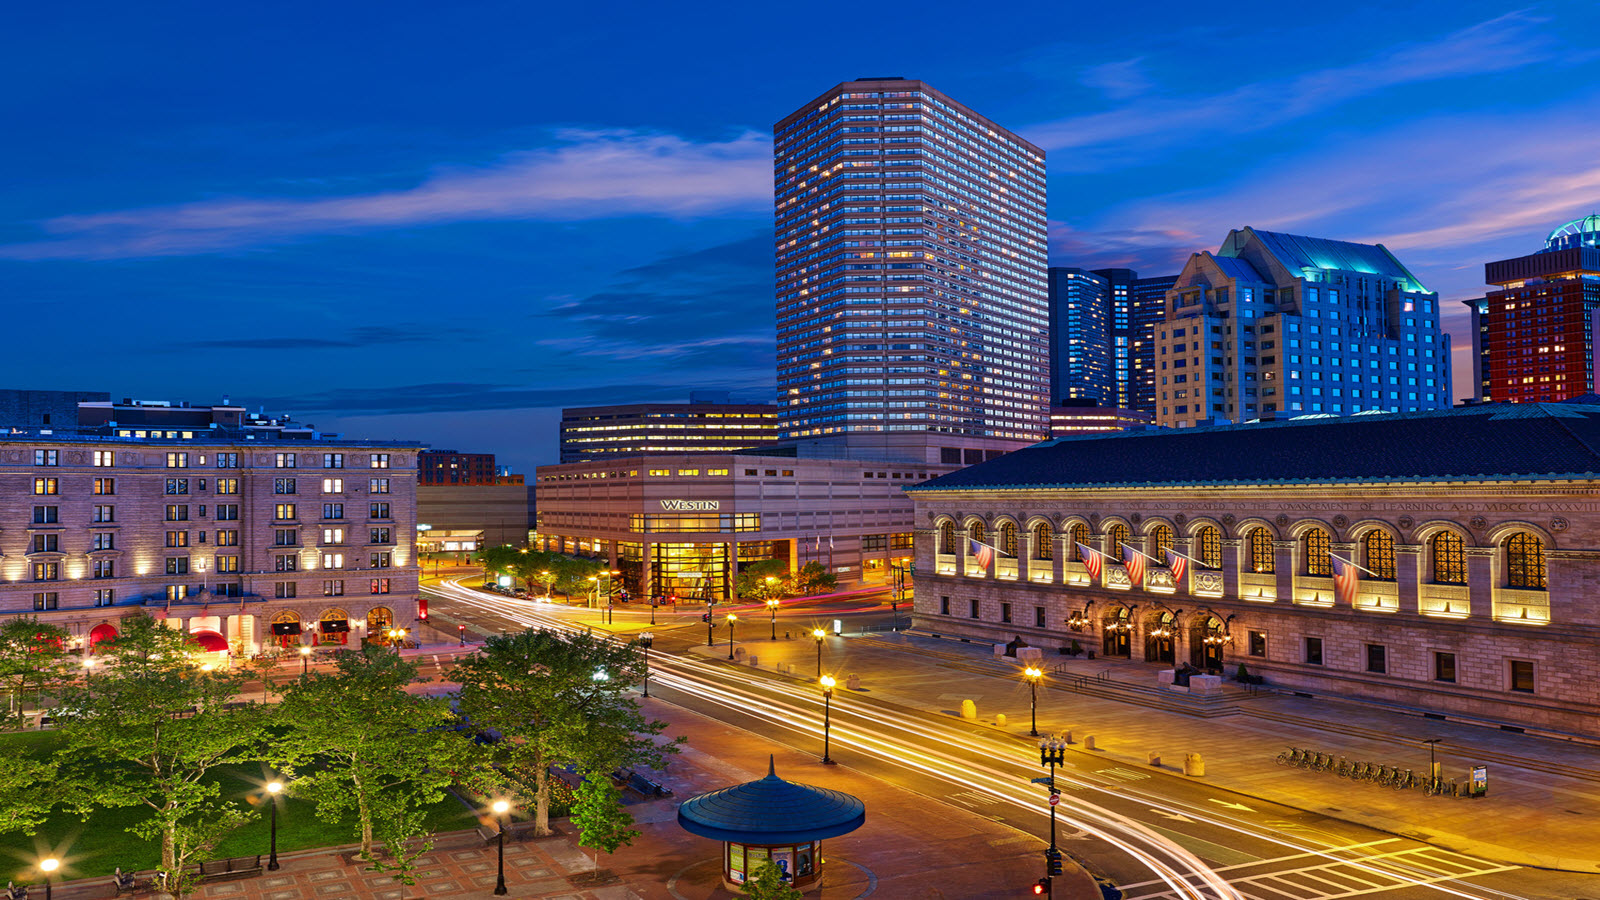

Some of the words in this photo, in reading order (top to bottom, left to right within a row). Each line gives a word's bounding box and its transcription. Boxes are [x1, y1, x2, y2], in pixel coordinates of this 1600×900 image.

[660, 499, 719, 511] WESTIN
[1032, 502, 1059, 510] BOSTON
[1251, 503, 1269, 511] THE
[1276, 503, 1352, 511] ADVANCEMENT
[1359, 503, 1375, 511] OF
[1383, 503, 1444, 511] LEARNING
